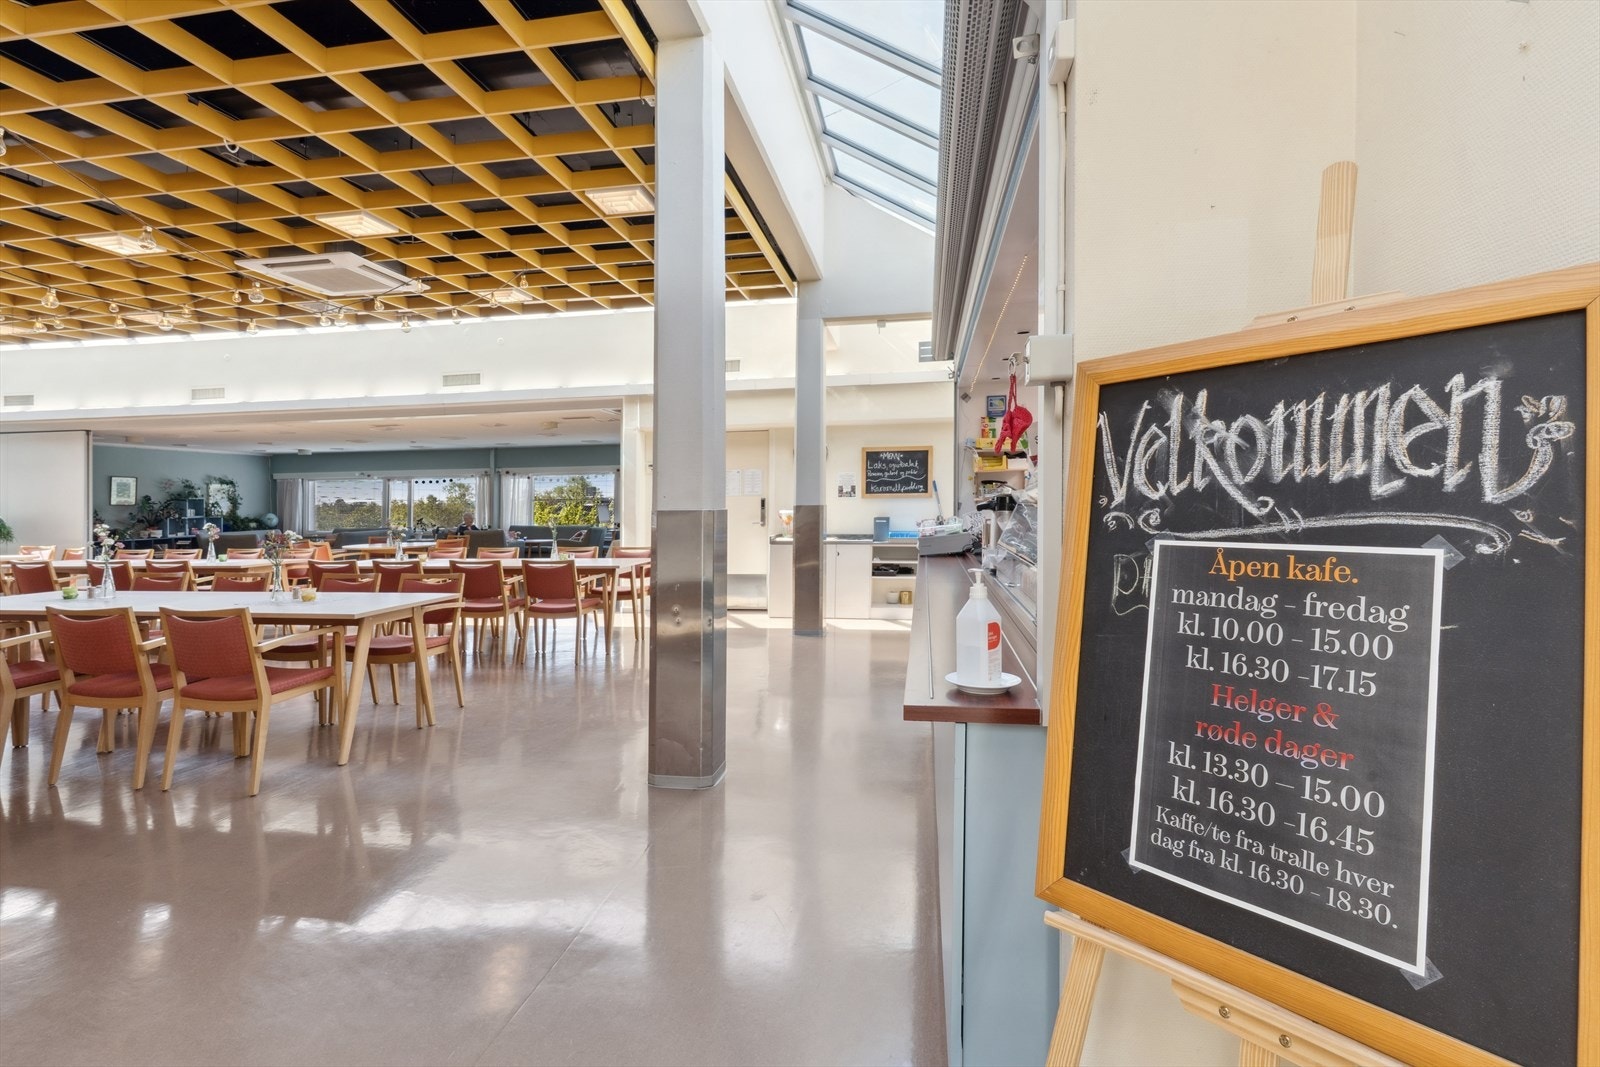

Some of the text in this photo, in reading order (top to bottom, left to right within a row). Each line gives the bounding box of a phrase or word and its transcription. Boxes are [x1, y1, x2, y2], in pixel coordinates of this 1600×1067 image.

[1097, 373, 1505, 516] Velkommen
[1209, 548, 1359, 584] Åpen kafe.
[1171, 586, 1278, 619] mandag
[1302, 592, 1410, 632] fredag
[1177, 611, 1206, 637] kl.
[1211, 616, 1284, 646] 10.00
[1310, 627, 1394, 661] 15.00
[1185, 645, 1214, 672] kl.
[1220, 651, 1289, 683] 16.30
[1210, 683, 1340, 730] Helger &
[1194, 719, 1355, 770] røde dager
[1167, 741, 1196, 770] kl.
[1202, 751, 1269, 788] 13.30
[1300, 775, 1385, 818] 15.00
[1171, 775, 1200, 806] kl.
[1206, 787, 1276, 827] 16.30
[1155, 805, 1395, 898] Kaffe/te fra tralle hver
[1150, 828, 1184, 858] dag
[1188, 840, 1216, 866] fra
[1220, 849, 1244, 875] kl.
[1249, 860, 1304, 896] 16.30
[1326, 887, 1399, 929] 18.30.
